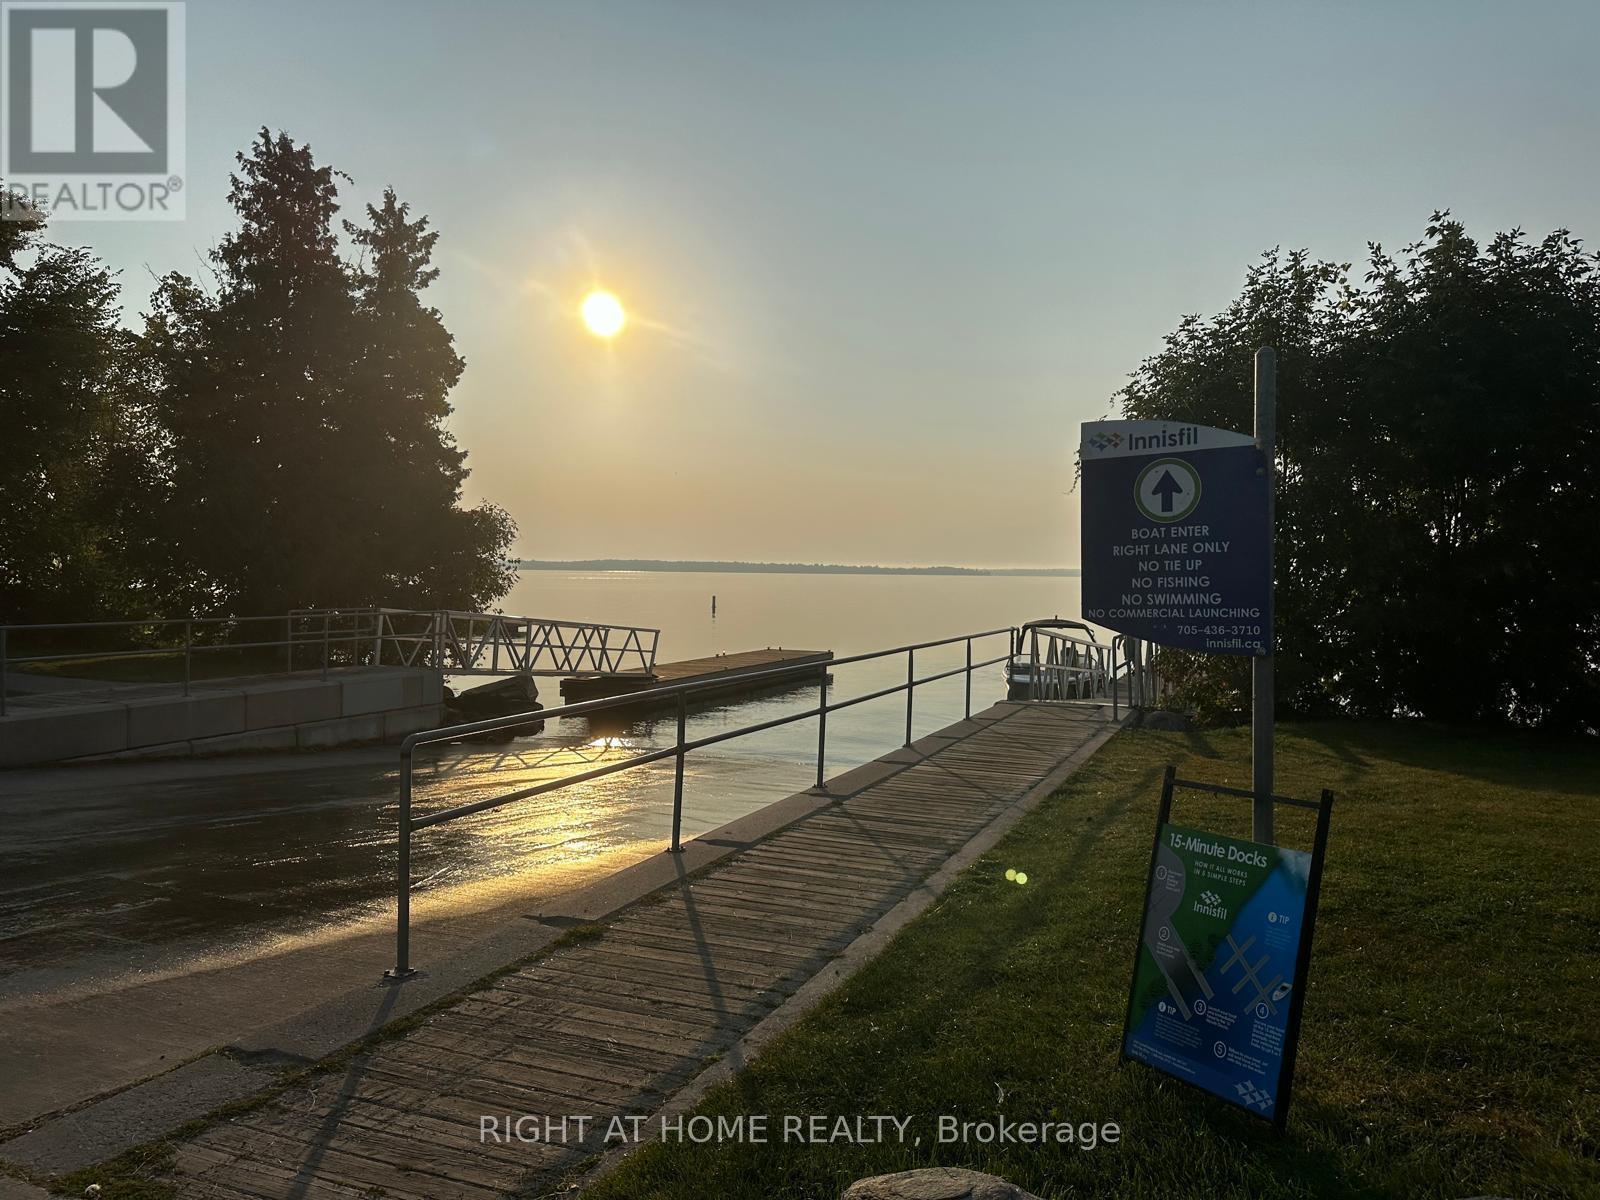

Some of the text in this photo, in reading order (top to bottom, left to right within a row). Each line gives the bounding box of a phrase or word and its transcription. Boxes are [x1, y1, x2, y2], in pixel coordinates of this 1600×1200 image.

[1129, 427, 1198, 450] Innisfil
[1131, 525, 1209, 540] BOAT ENTER
[1113, 541, 1230, 556] RIGHT LANE ONLY
[1139, 560, 1202, 572] NO TIE UP
[1131, 576, 1210, 589] NO FISHING
[1122, 593, 1222, 606] NO SWIMMING
[1088, 608, 1260, 619] NO COMMERCIAL LAUNCHING
[1177, 625, 1261, 636] 705-436-3710
[1206, 638, 1261, 649] innisfil.ca
[1170, 833, 1268, 868] 15-Minute Docks
[1194, 861, 1208, 869] HOW
[1216, 864, 1225, 873] ALL
[1227, 867, 1248, 878] WORKS
[1193, 868, 1200, 876] IN
[1207, 871, 1227, 882] SIMPLE
[1229, 876, 1246, 887] STEPS
[1193, 900, 1227, 920] Innisfil
[1279, 915, 1290, 925] TIP
[1168, 1005, 1177, 1015] TIP
